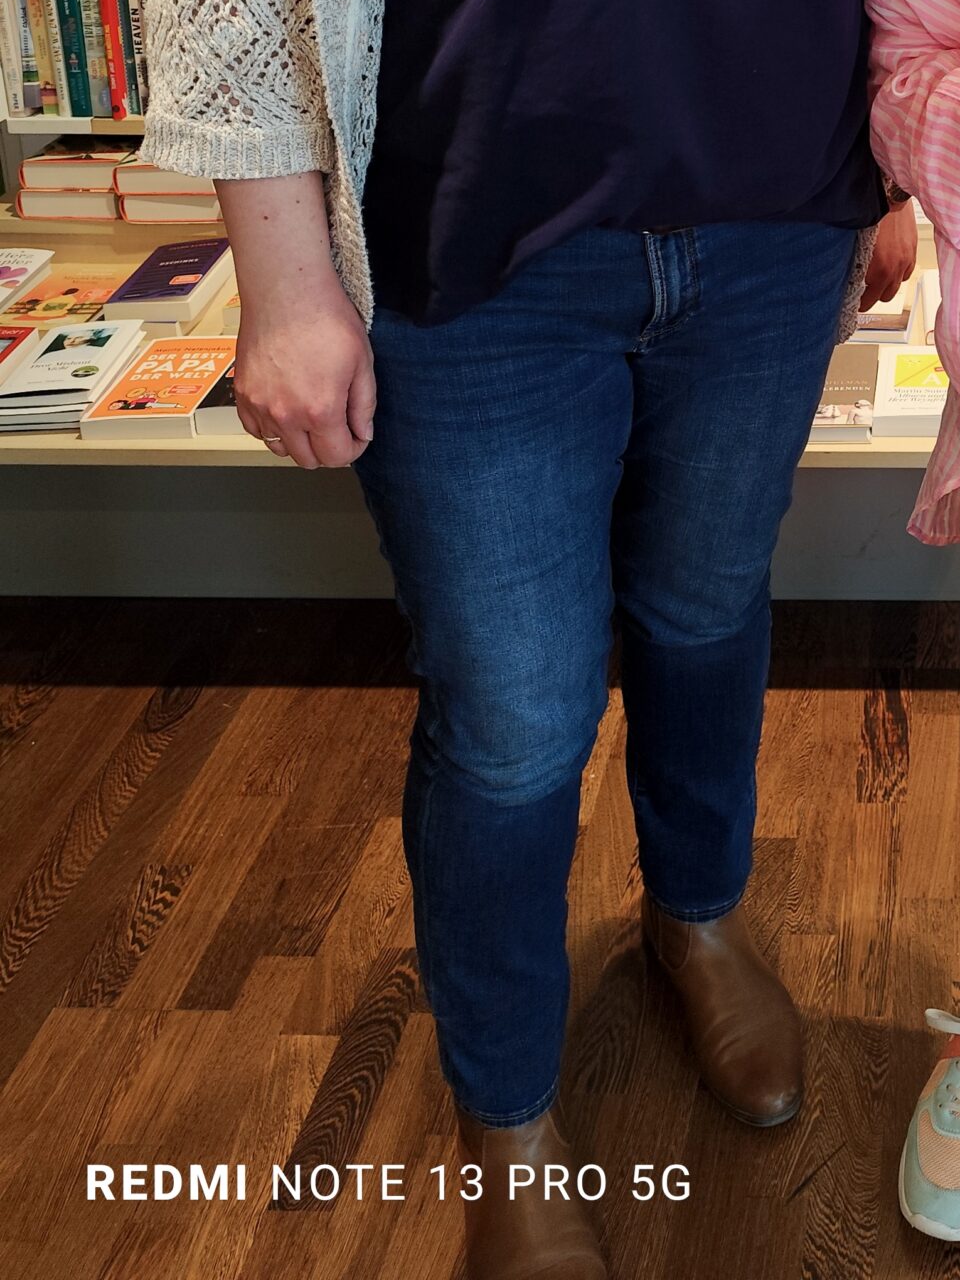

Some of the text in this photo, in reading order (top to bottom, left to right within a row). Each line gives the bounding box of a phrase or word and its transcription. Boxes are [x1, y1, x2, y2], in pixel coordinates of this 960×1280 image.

[130, 7, 144, 55] HEAVEN
[147, 351, 228, 361] DER BESTE
[129, 371, 213, 381] DER WELT
